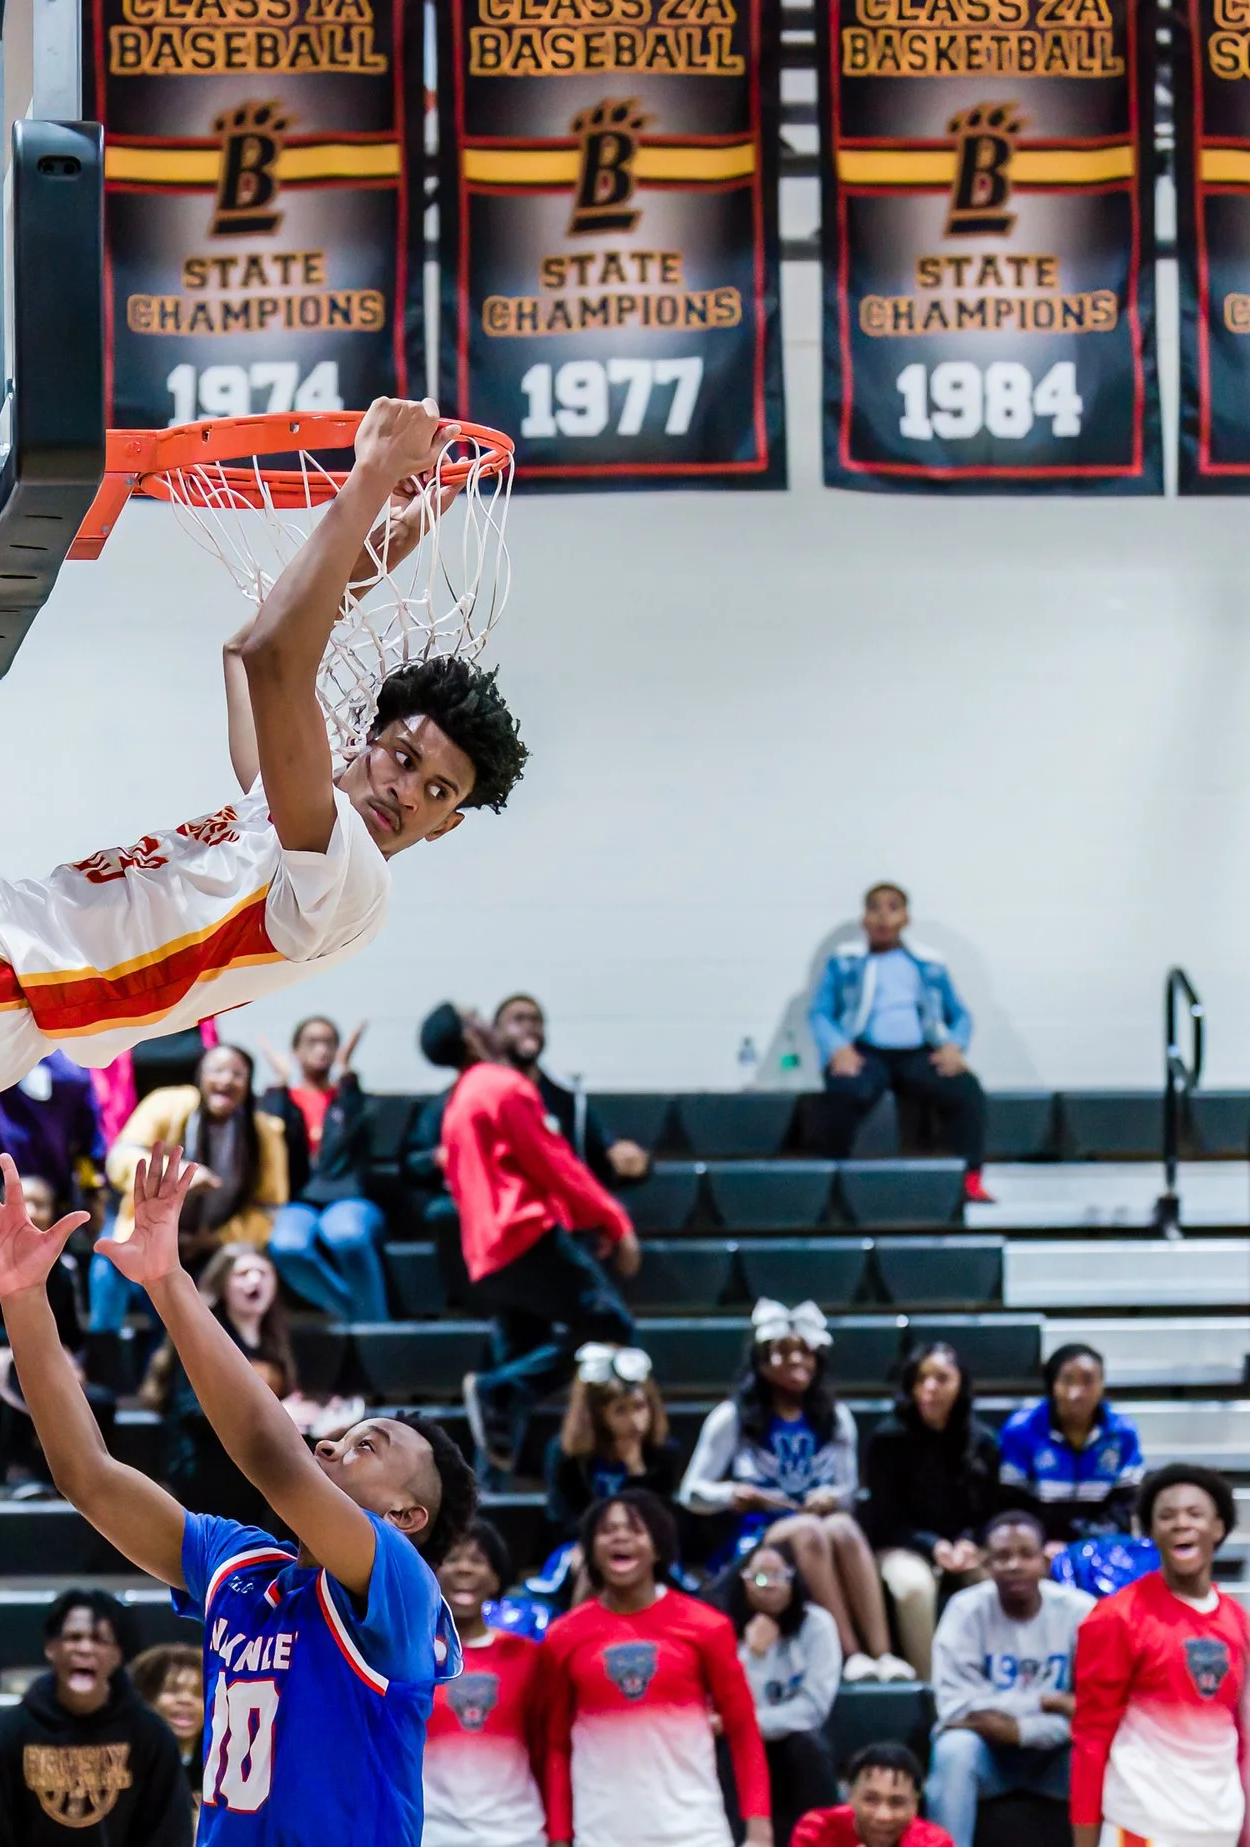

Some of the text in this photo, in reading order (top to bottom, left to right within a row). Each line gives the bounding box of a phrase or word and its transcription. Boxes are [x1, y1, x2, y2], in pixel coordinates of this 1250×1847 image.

[111, 26, 387, 74] BASEBALL
[471, 27, 745, 75] BASEBALL
[844, 28, 1124, 76] BASKETBALL
[183, 250, 326, 290] STATE
[541, 250, 684, 290] STATE
[915, 255, 1058, 290] STATE
[128, 289, 384, 334] CHAMPIONS
[483, 288, 741, 336] CHAMPIONS
[859, 291, 1116, 336] CHAMPIONS
[166, 361, 344, 427] 1974
[520, 356, 704, 438] 1977
[896, 361, 1083, 440] 1984
